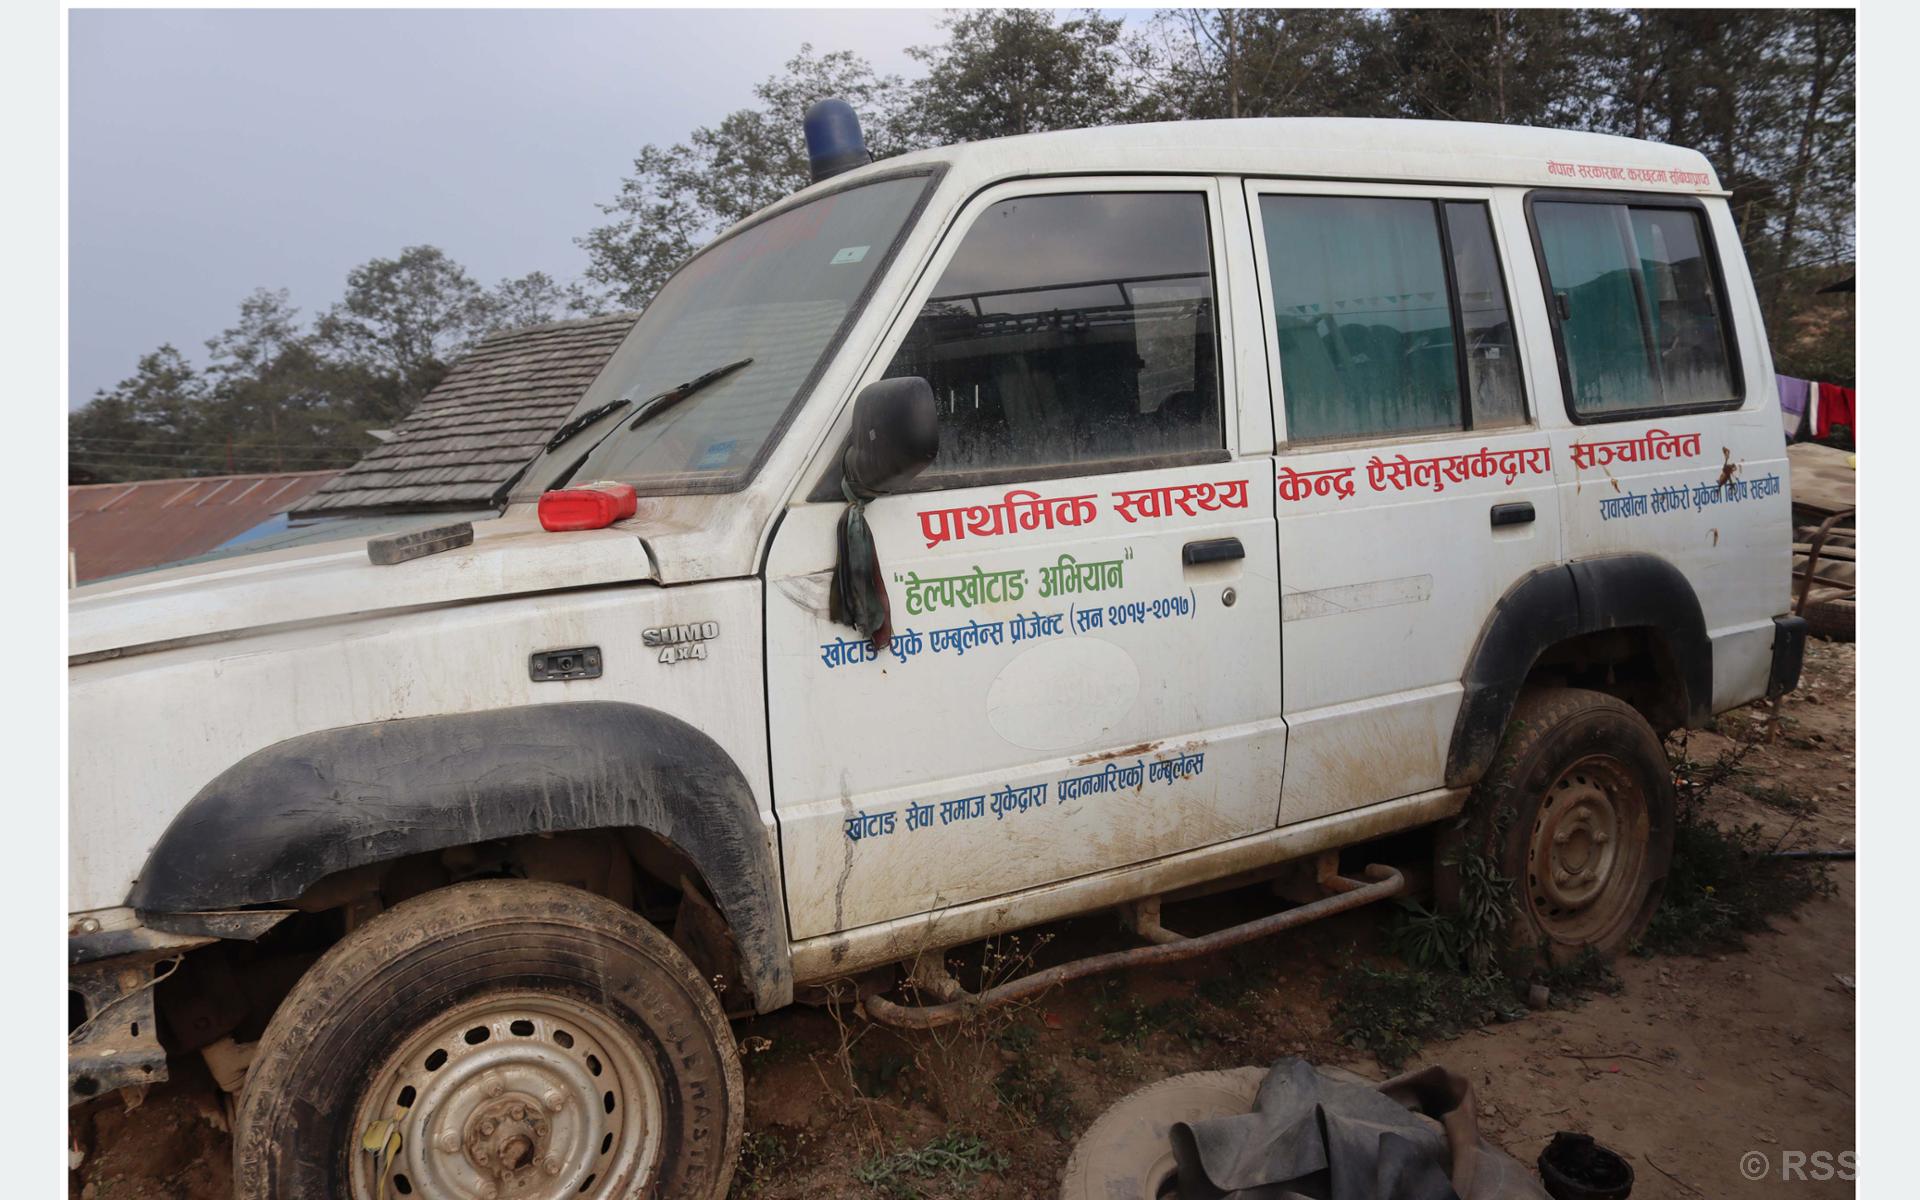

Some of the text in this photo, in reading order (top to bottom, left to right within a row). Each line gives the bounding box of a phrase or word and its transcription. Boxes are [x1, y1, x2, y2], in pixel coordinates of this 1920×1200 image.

[917, 489, 1098, 549] प्राथमिक
[1111, 480, 1250, 524] स्वास्थ्य
[1277, 466, 1356, 502] केन्द्र
[1569, 429, 1702, 470] सञ्चालित
[642, 621, 719, 646] SUMO
[889, 628, 923, 664] युके
[929, 619, 1004, 656] एम्बुलेन्स
[1010, 611, 1065, 645] प्रोजेक्ट
[905, 801, 935, 832] सेवा
[939, 795, 986, 826] समाज
[1149, 752, 1205, 786] एम्बुलेन्स
